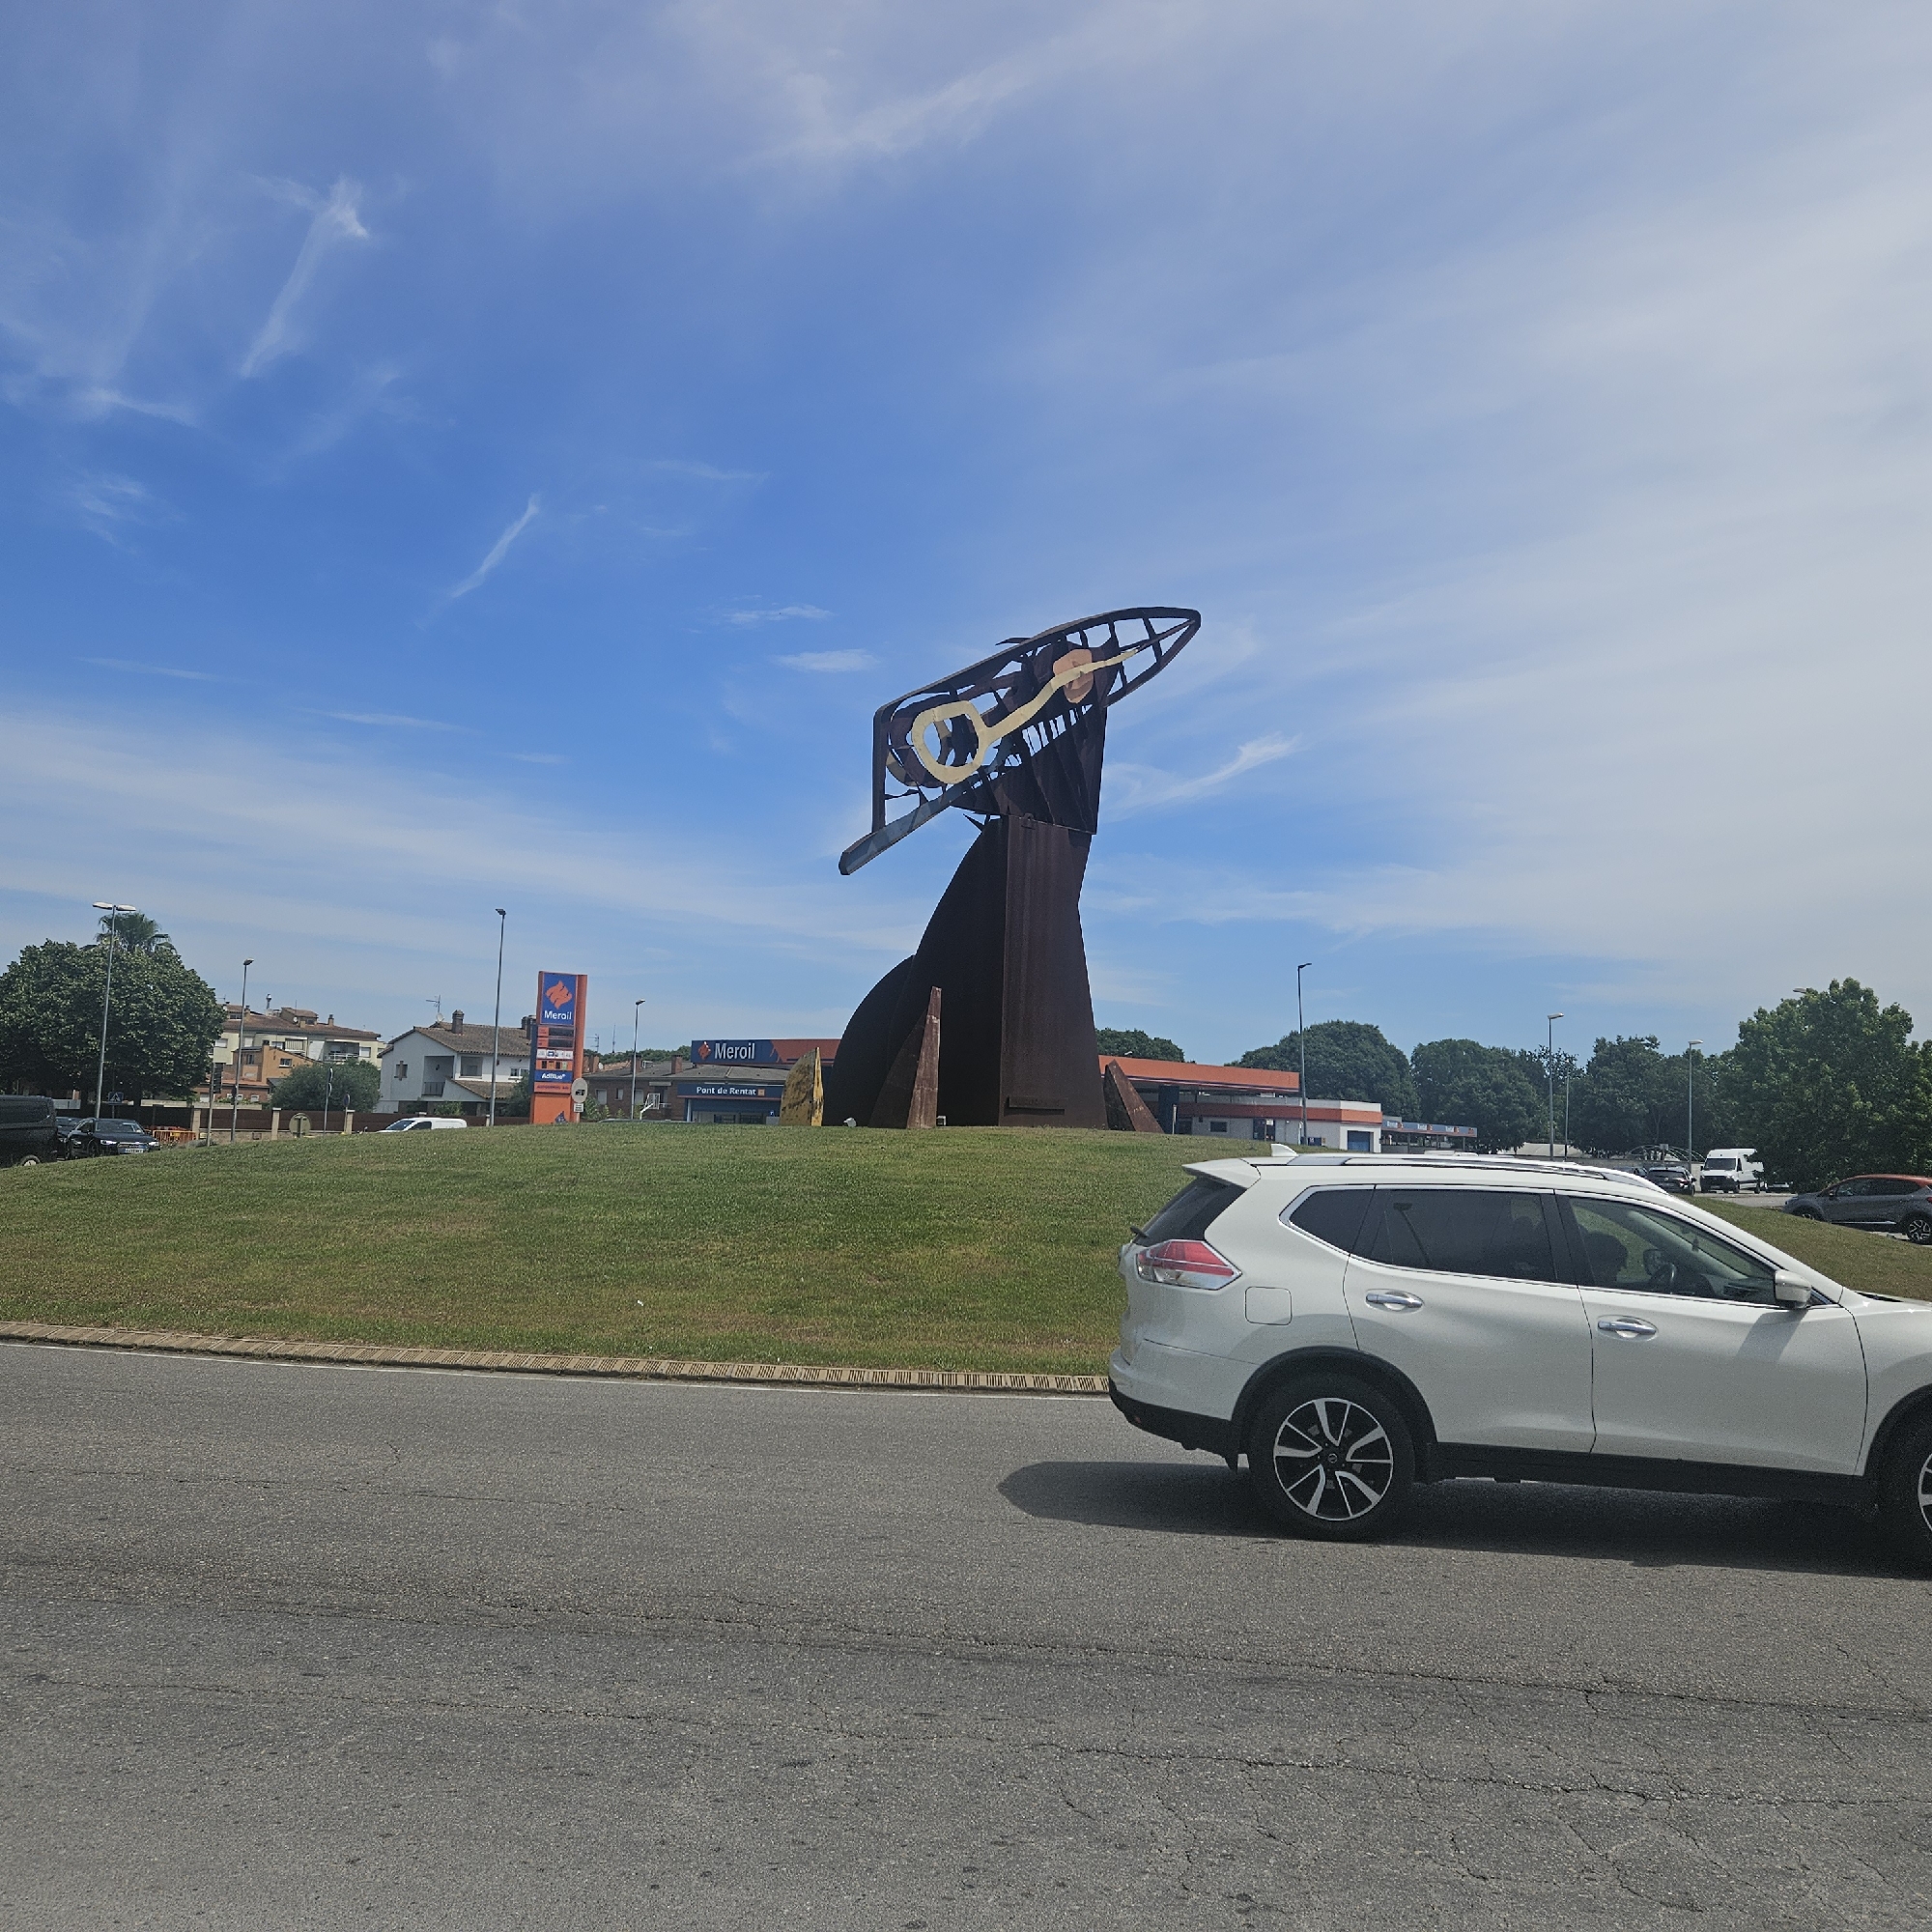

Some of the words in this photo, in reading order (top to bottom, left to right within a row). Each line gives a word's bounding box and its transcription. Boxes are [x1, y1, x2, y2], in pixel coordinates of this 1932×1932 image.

[544, 1009, 572, 1020] Meroil
[715, 1042, 755, 1060] Meroil
[696, 1086, 715, 1094] Pont
